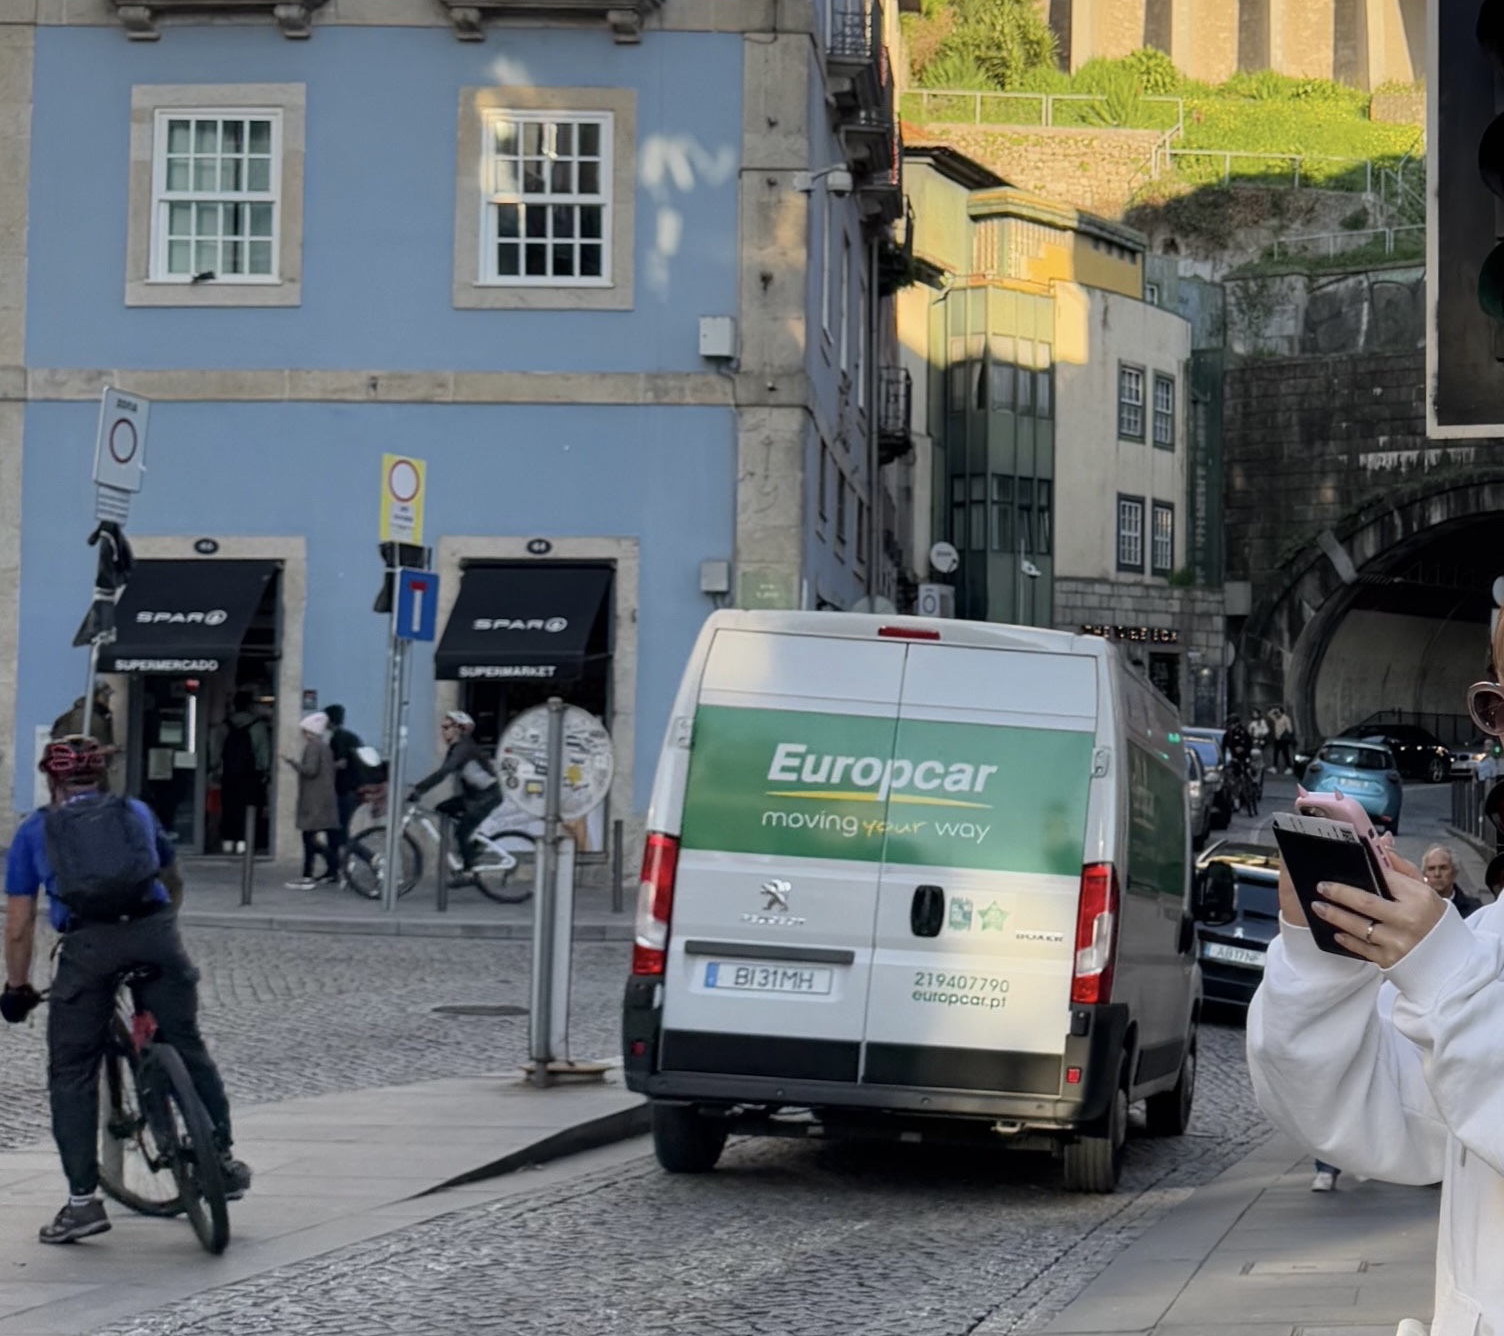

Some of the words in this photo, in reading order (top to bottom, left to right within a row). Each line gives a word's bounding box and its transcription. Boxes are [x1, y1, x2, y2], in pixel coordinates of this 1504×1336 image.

[136, 611, 203, 624] SPAR
[473, 618, 545, 631] SPAR
[115, 659, 219, 672] SUPERMERCADO
[458, 666, 557, 678] SUPERMARKET
[767, 742, 998, 802] Europcar
[762, 811, 859, 837] moving
[862, 820, 929, 838] your
[935, 821, 991, 844] way
[914, 971, 1010, 994] 219407790
[911, 990, 1007, 1010] europcar.pt
